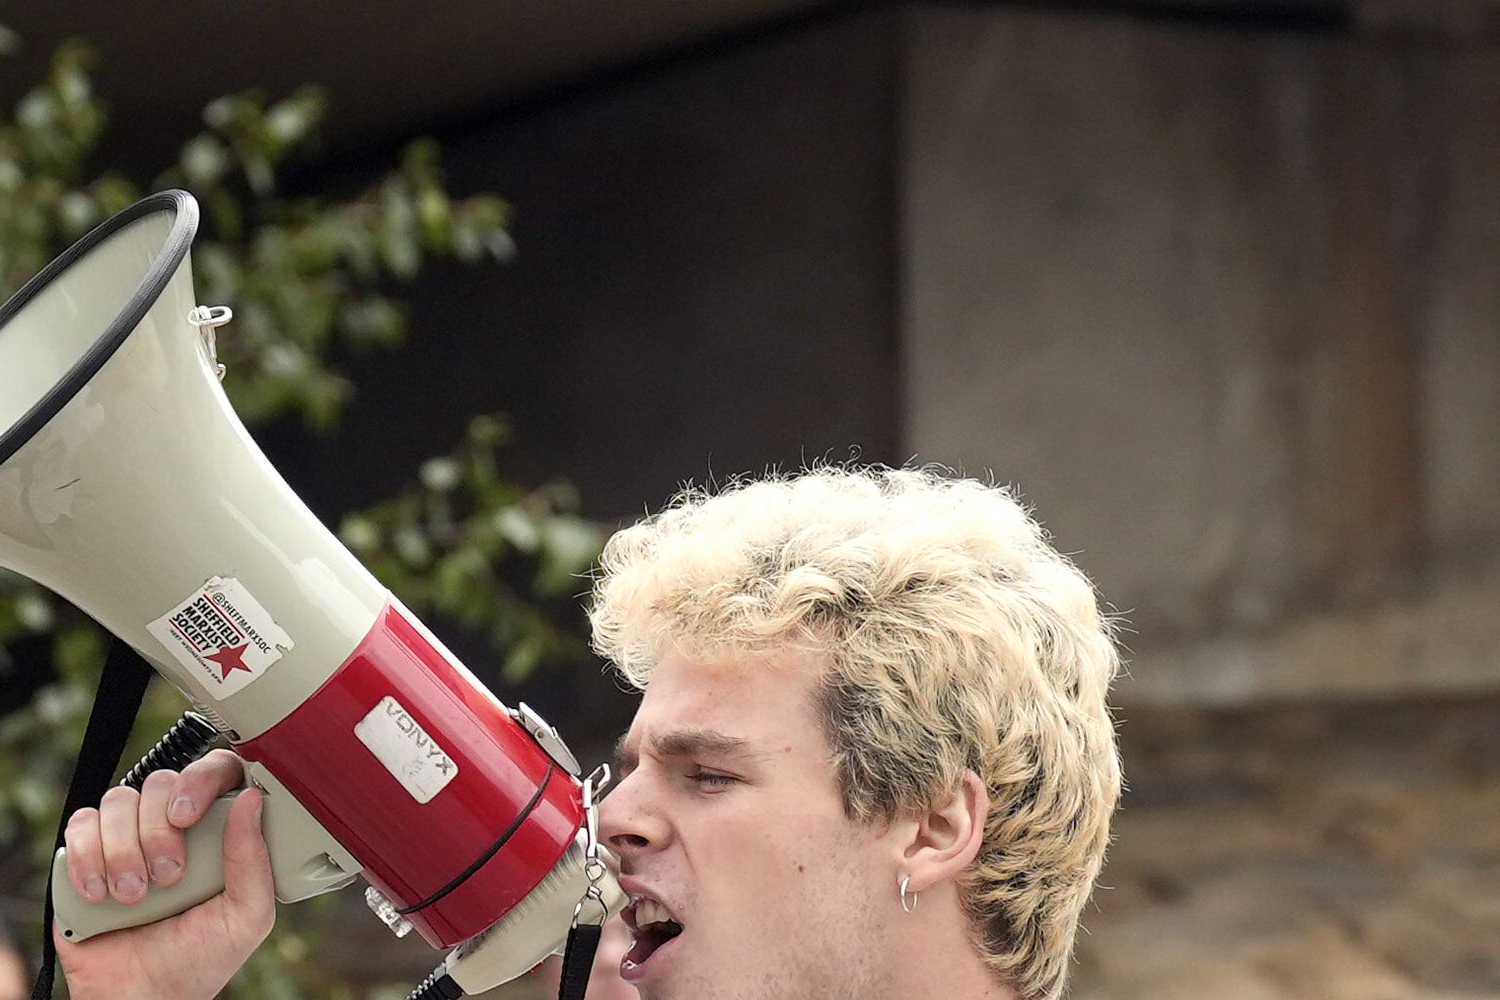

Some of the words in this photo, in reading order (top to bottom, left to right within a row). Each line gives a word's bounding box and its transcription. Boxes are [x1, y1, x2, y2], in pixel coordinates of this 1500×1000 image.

[172, 613, 212, 652] SOCIETY
[182, 606, 225, 649] MARXIST
[193, 597, 241, 646] SHEFFIELD
[212, 592, 272, 654] @SHEFFMARXSOC
[385, 702, 455, 776] VONYX
